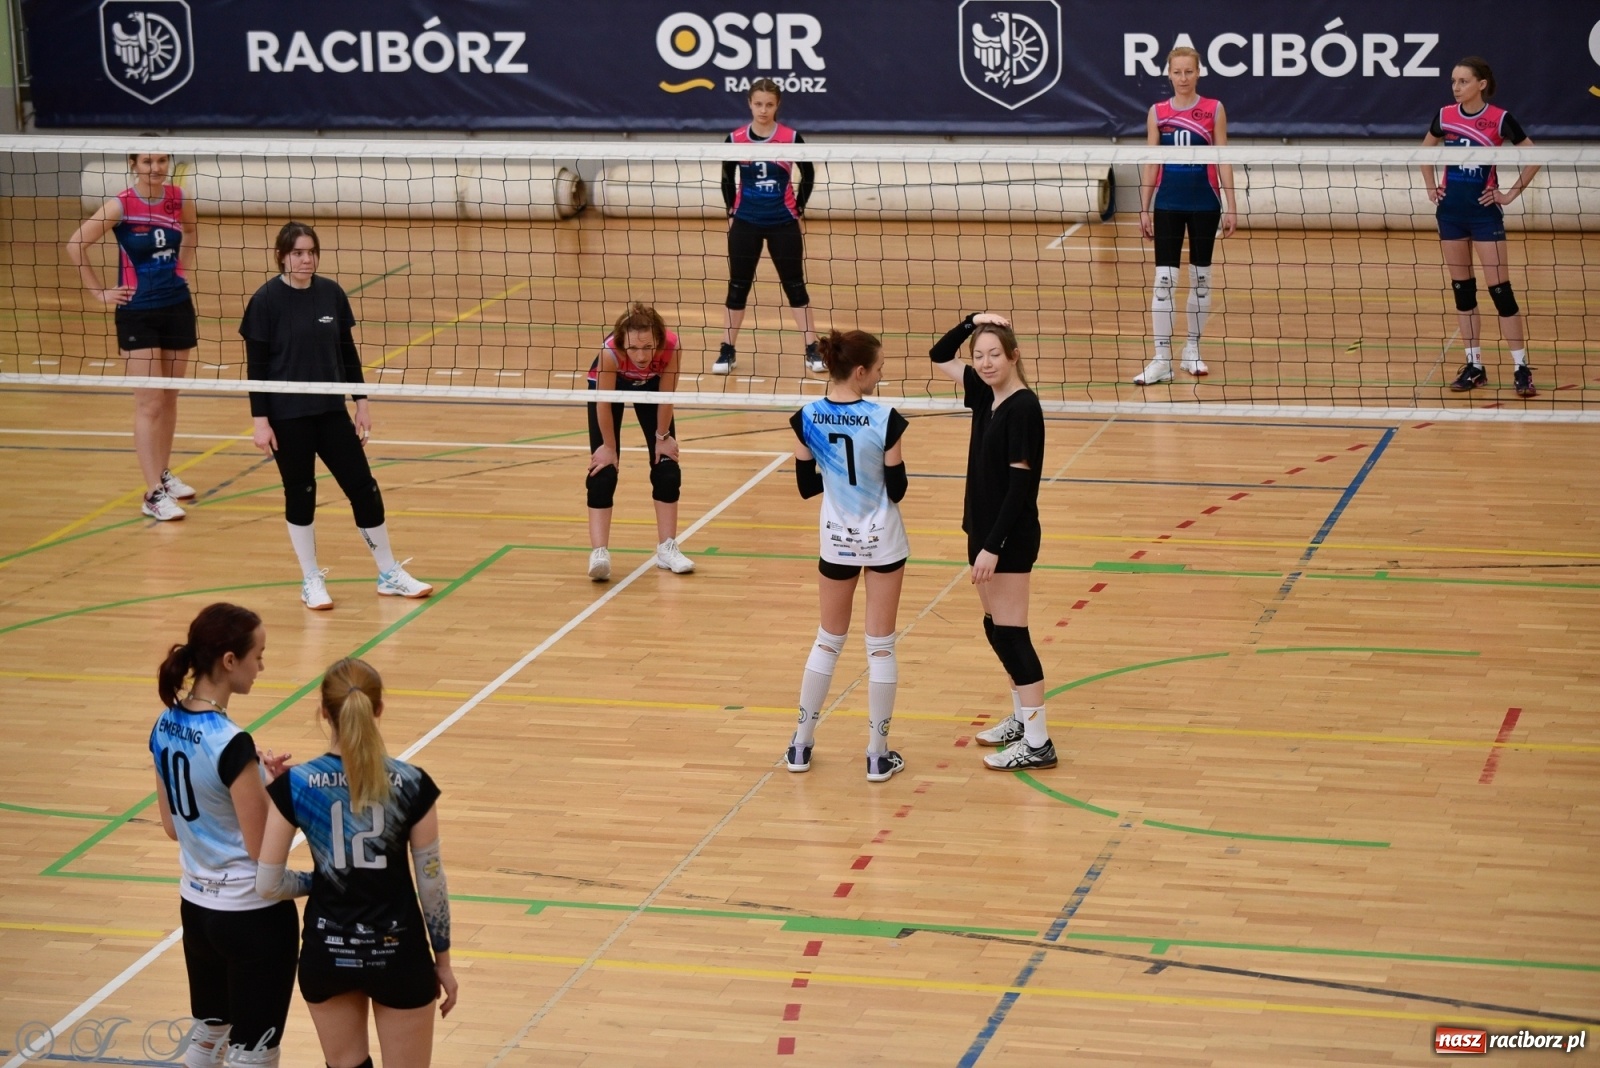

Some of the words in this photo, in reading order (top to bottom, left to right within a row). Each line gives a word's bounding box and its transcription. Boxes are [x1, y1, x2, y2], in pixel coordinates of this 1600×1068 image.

[246, 16, 529, 74] RACIBÓRZ
[724, 72, 827, 93] RABÓRZ
[755, 161, 768, 179] 3
[154, 228, 167, 248] 8
[812, 411, 870, 427] ŻUKLIŃSKA
[828, 433, 857, 486] 7
[158, 718, 203, 745] EMERLING
[160, 746, 200, 822] 10
[308, 772, 403, 788] MAJKKA
[331, 800, 387, 869] 12
